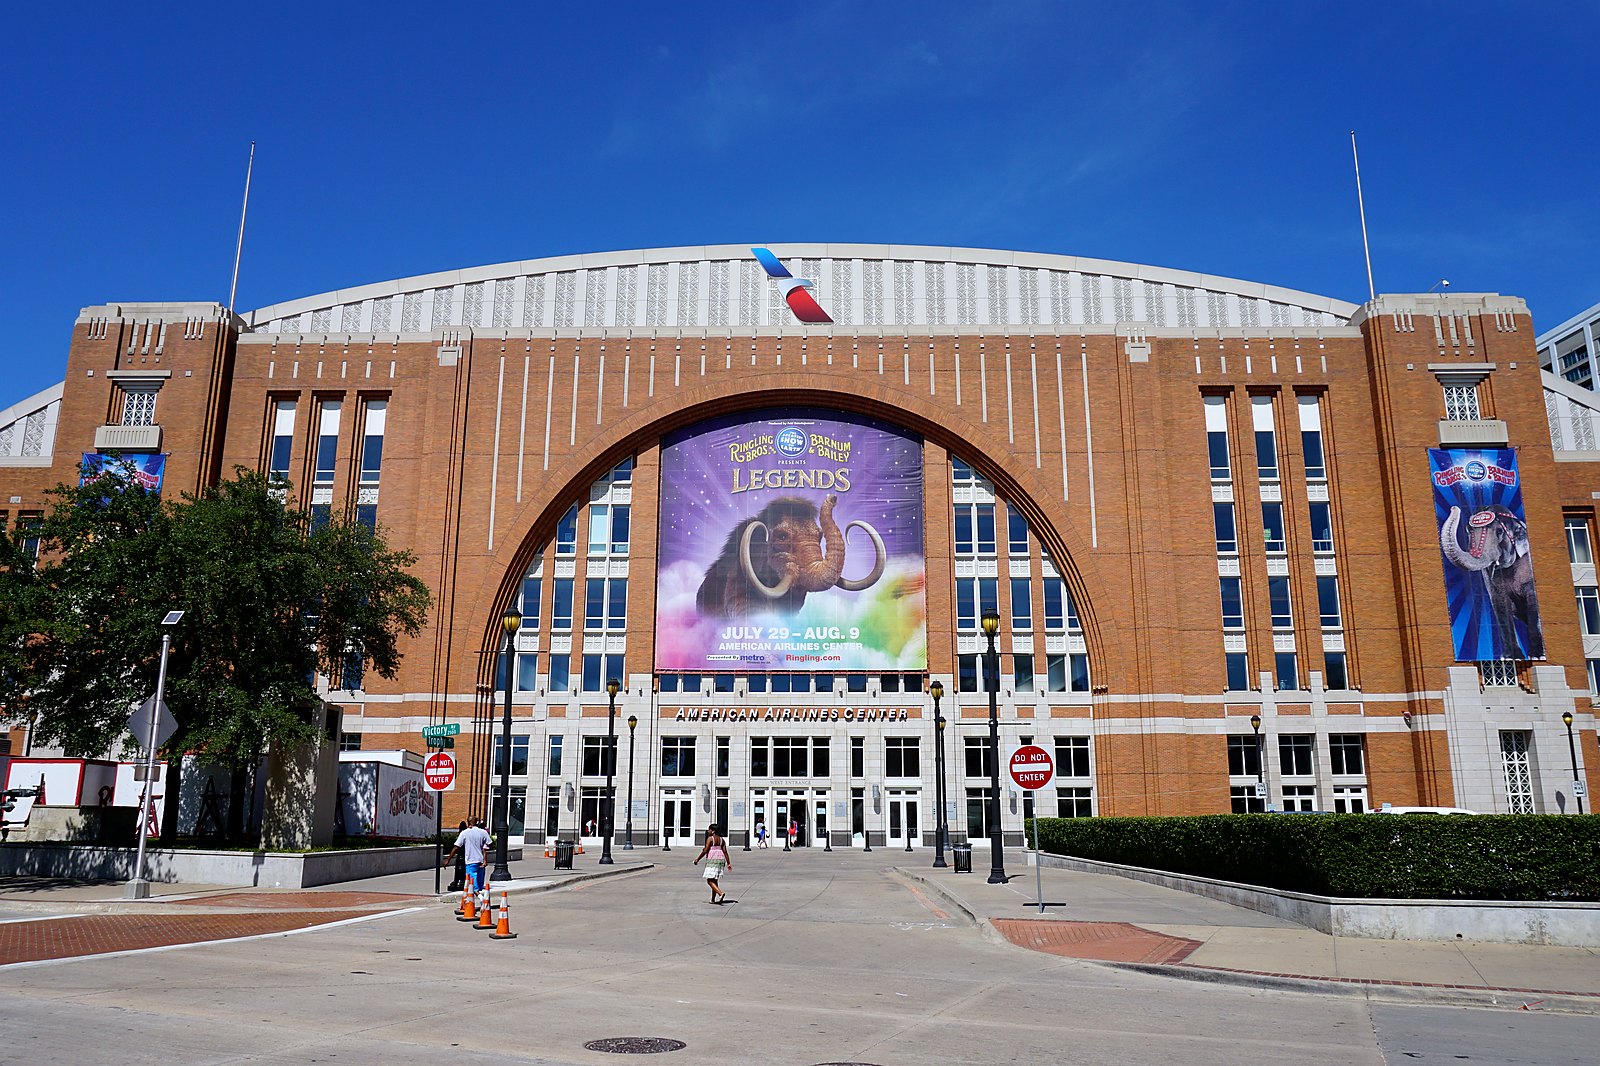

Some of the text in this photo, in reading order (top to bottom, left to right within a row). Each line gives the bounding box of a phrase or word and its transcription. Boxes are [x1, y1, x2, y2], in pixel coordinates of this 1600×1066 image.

[780, 437, 804, 446] SHOW
[809, 433, 851, 452] BARNUM
[729, 435, 774, 463] RINGLING
[745, 445, 771, 462] BROS.
[816, 444, 850, 463] BAILEY
[731, 468, 851, 494] LEGENDS
[722, 627, 764, 640] JULY
[768, 627, 790, 640] 29
[804, 627, 846, 640] AUG.
[849, 627, 860, 639] 9
[719, 642, 863, 651] AMERICAN AIRLINES CENTER
[785, 654, 841, 662] Ringling.com
[676, 706, 909, 721] AMERICAN AIRLINES CENTER
[423, 726, 448, 737] Victory
[428, 736, 447, 748] Trophy
[1015, 753, 1046, 762] DO NOT
[429, 776, 449, 784] ENTER
[1020, 773, 1045, 782] ENTER
